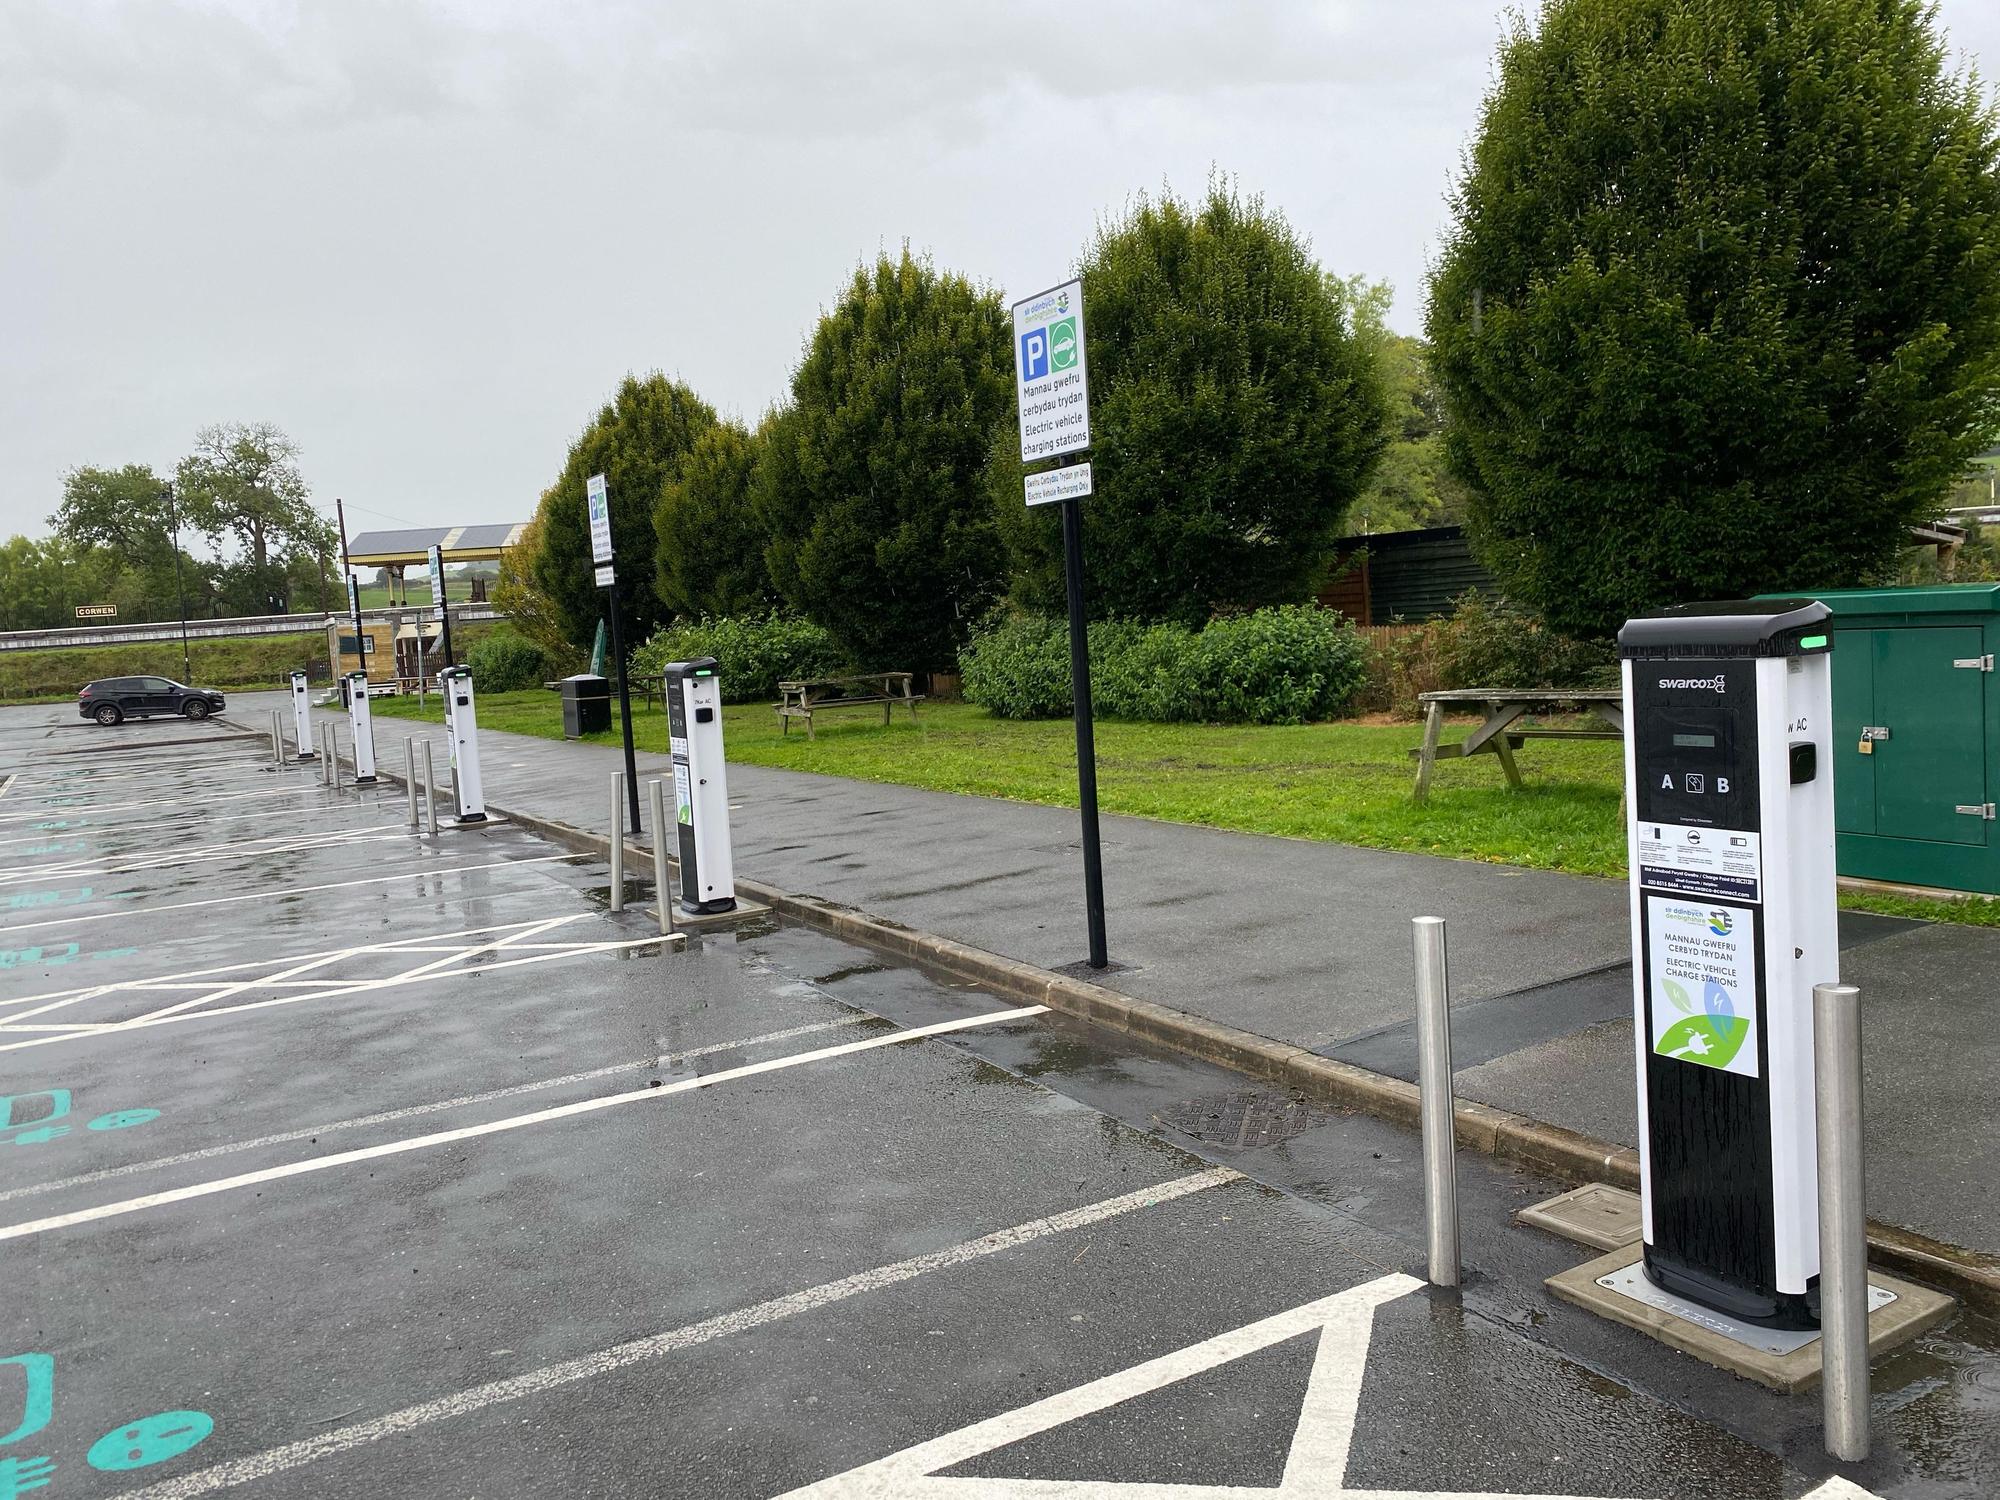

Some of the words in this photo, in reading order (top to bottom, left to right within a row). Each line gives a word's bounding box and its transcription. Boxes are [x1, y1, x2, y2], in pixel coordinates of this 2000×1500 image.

[1027, 335, 1044, 376] P
[1023, 382, 1052, 399] Mannau
[1053, 373, 1080, 392] gwefru
[1023, 400, 1056, 417] cerbydau
[1058, 392, 1083, 408] trydan
[1025, 420, 1053, 437] Electric
[1055, 412, 1083, 429] vehicle
[1023, 439, 1054, 455] charging
[1056, 431, 1087, 448] stations
[78, 607, 114, 616] CORWEN
[1658, 678, 1708, 689] swarco
[1796, 717, 1808, 731] AC
[1661, 774, 1674, 790] A
[1717, 777, 1730, 793] B
[1673, 908, 1704, 918] ddinbych
[1664, 933, 1701, 946] MANNAU
[1702, 939, 1737, 952] GWEFRU
[1668, 944, 1699, 956] CERBYD
[1700, 949, 1733, 961] TRYDAN
[1666, 957, 1701, 970] ELECTRIC
[1702, 964, 1737, 977] VEHICLE
[1665, 967, 1699, 981] CHARGE
[1701, 974, 1738, 988] STATIONS
